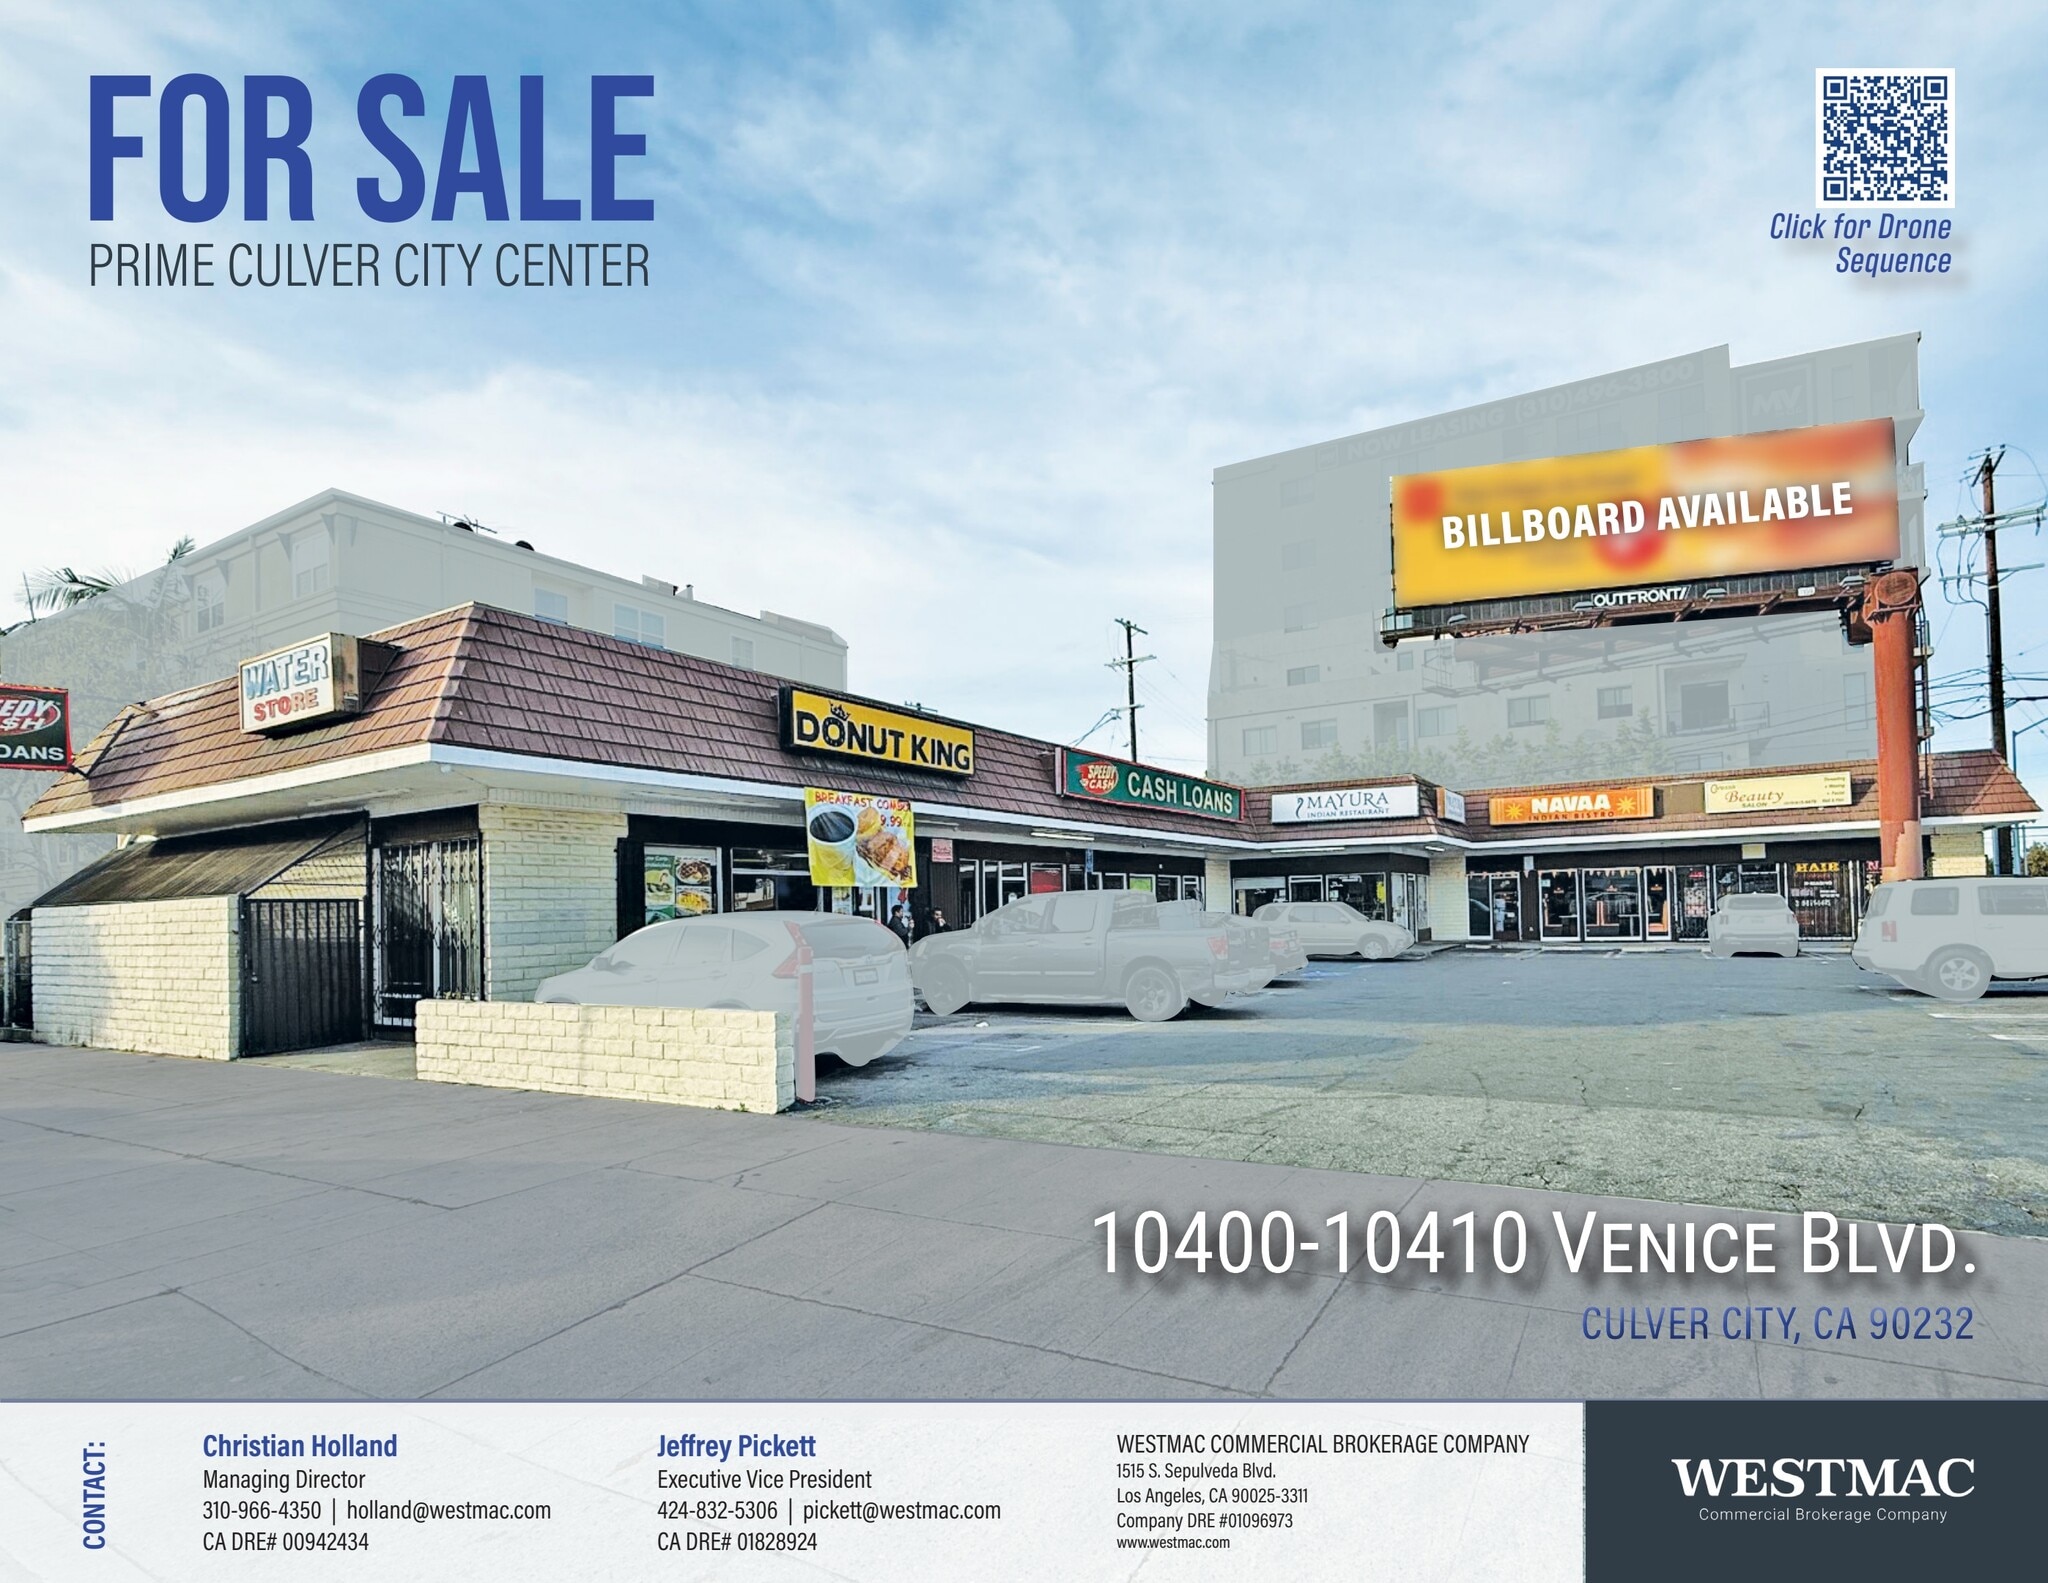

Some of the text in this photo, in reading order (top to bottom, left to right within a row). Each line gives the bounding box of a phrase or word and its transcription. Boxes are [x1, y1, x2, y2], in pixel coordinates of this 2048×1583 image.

[243, 644, 330, 701] WATER
[254, 687, 320, 722] STORE
[796, 710, 971, 771] DONUT KING
[1088, 765, 1117, 779] SPEEDY
[815, 791, 873, 808] BREAKFAST
[1127, 772, 1233, 815] CASH LOANS
[1307, 791, 1390, 811] MAYURA
[1725, 790, 1784, 804] Beauty
[1307, 807, 1390, 818] INDIAN RESTAURANT
[1531, 794, 1611, 814] NAVAA
[1528, 811, 1615, 822] INDIAN BISTRO
[1795, 862, 1840, 873] HAIR
